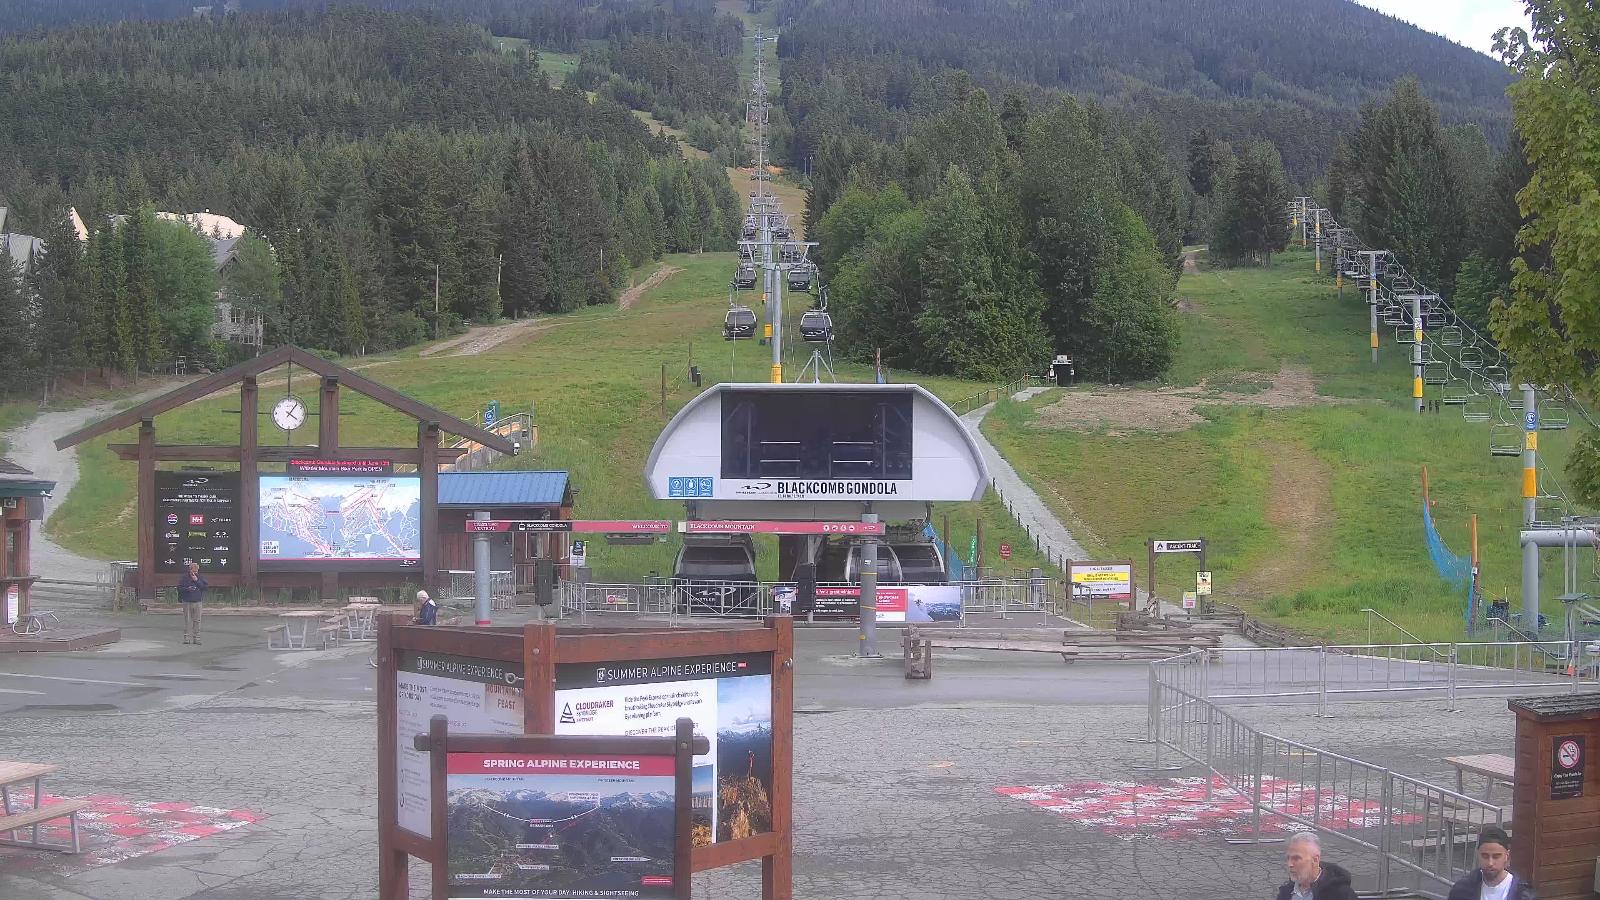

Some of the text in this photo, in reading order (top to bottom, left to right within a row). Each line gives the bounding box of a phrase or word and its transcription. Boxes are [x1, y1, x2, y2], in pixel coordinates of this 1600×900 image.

[777, 482, 898, 494] BLACKCOMB GONDOLA
[422, 660, 503, 679] SUMMER ALPINE EXPERIENCE
[608, 662, 736, 681] SUMMER ALPINE EXPERIENCE
[498, 700, 515, 710] FEAST
[576, 700, 614, 710] CLOUDRAKER
[483, 759, 640, 769] SPRING ALPINE EXPERIENCE
